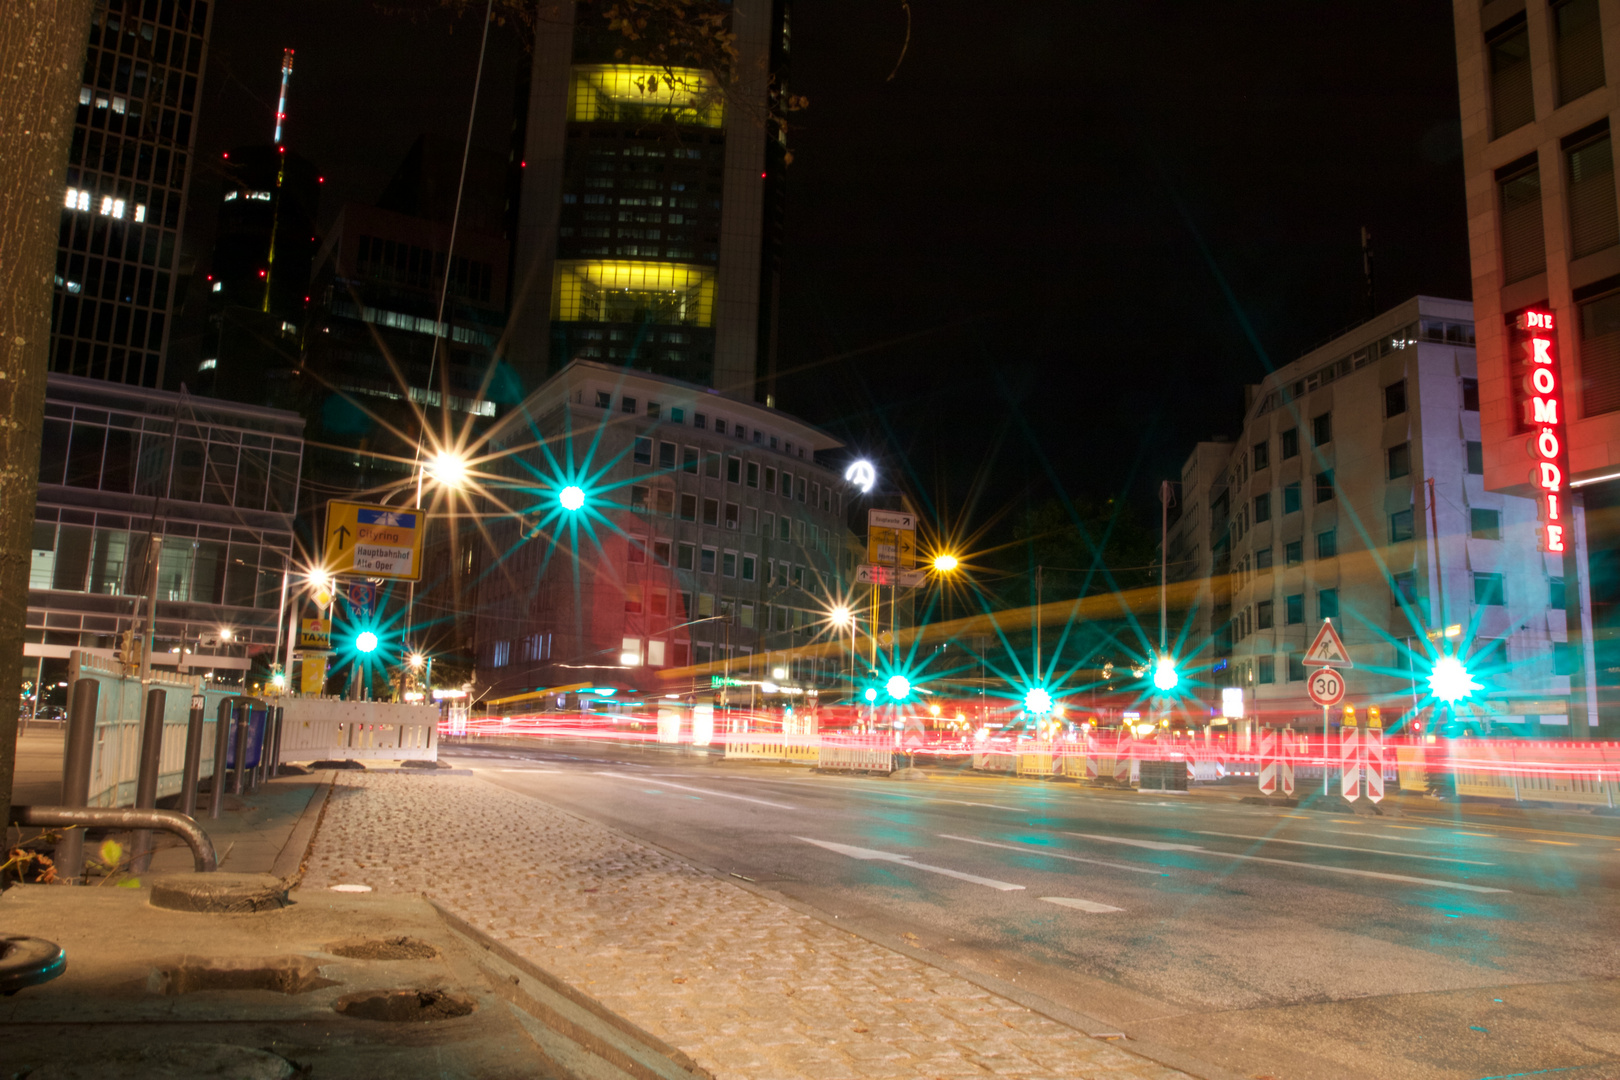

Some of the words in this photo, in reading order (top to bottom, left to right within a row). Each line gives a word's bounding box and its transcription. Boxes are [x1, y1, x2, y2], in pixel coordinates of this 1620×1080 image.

[1527, 311, 1553, 329] DIE
[1531, 337, 1565, 553] KOMÖDIE
[359, 528, 399, 543] Cityring
[357, 546, 410, 560] Hauptbahnhof
[357, 558, 372, 568] Alte
[375, 560, 394, 572] Oper
[351, 606, 372, 617] TAXI
[302, 632, 329, 642] TAXI
[1316, 678, 1337, 695] 30
